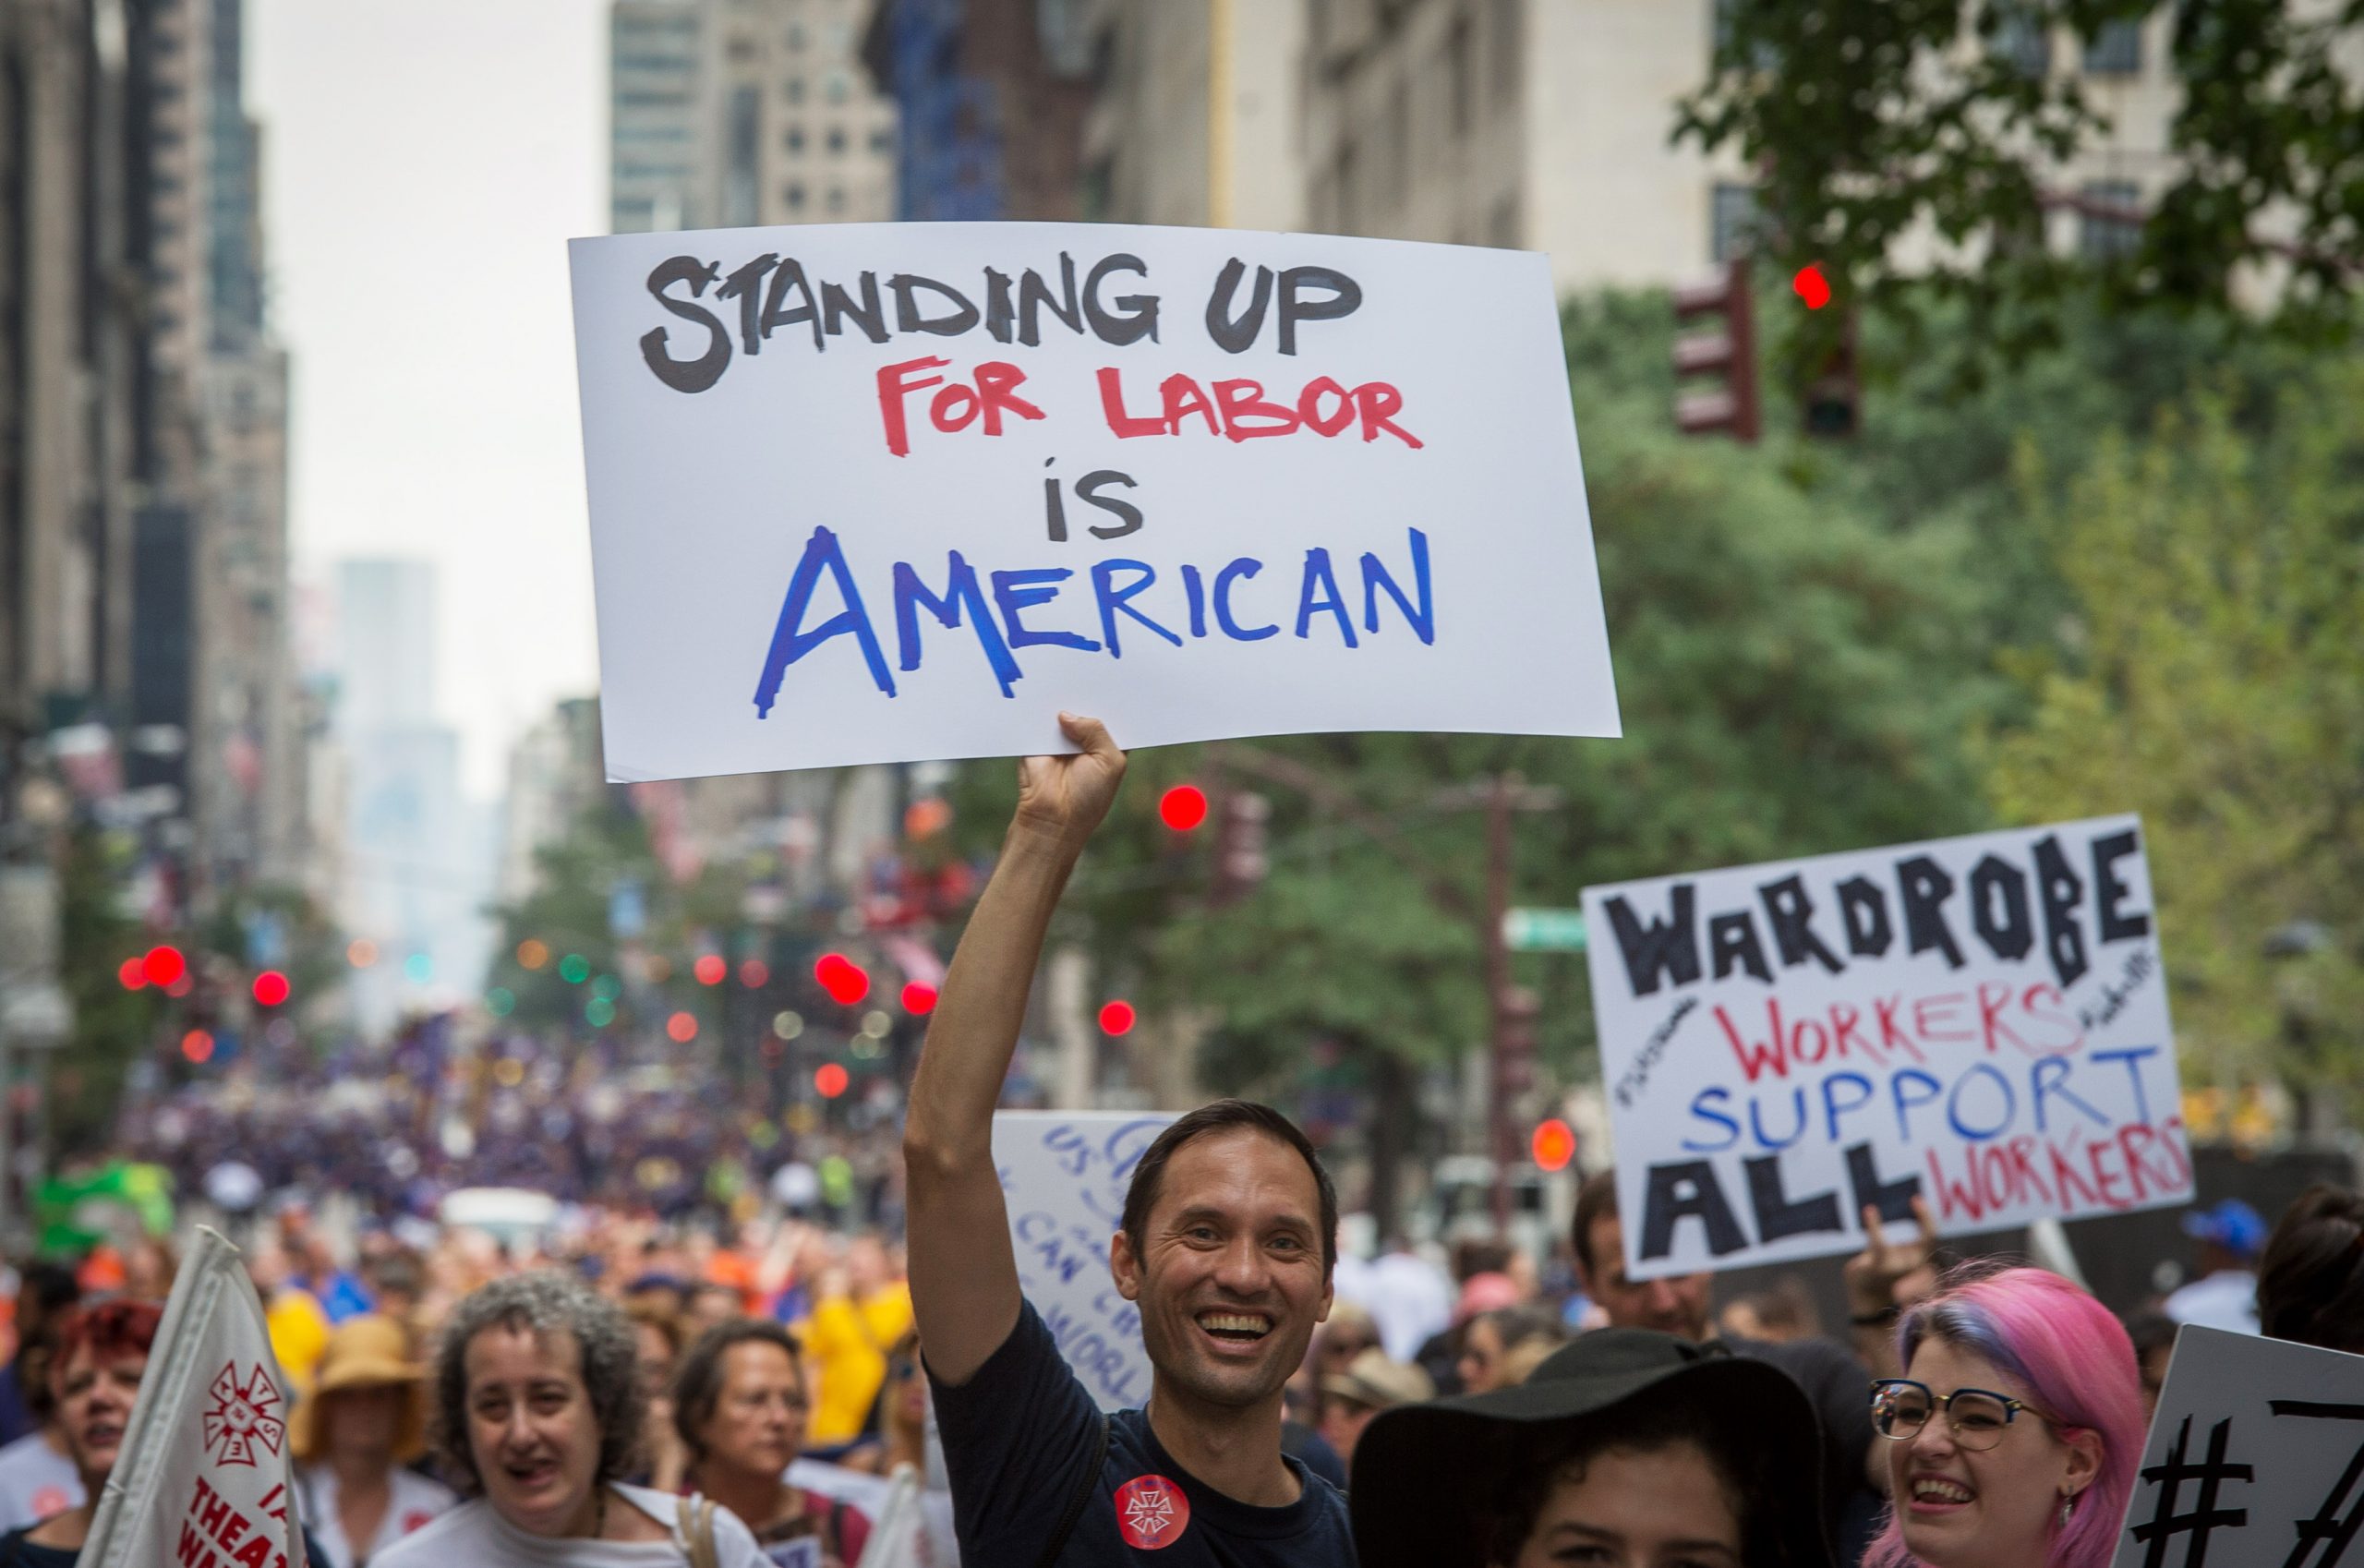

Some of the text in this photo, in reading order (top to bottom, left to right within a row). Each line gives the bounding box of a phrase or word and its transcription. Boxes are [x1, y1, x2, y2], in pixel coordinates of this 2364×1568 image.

[641, 251, 1362, 394] STANDING UP
[876, 355, 1425, 458] FOR LABOR
[753, 525, 1436, 720] AMERICAN
[1602, 830, 2150, 998] WARDROBE
[1681, 1044, 2160, 1152] SUPPORT
[1713, 981, 2085, 1083] WORKERS
[1638, 1116, 2191, 1262] ALL WORKERS
